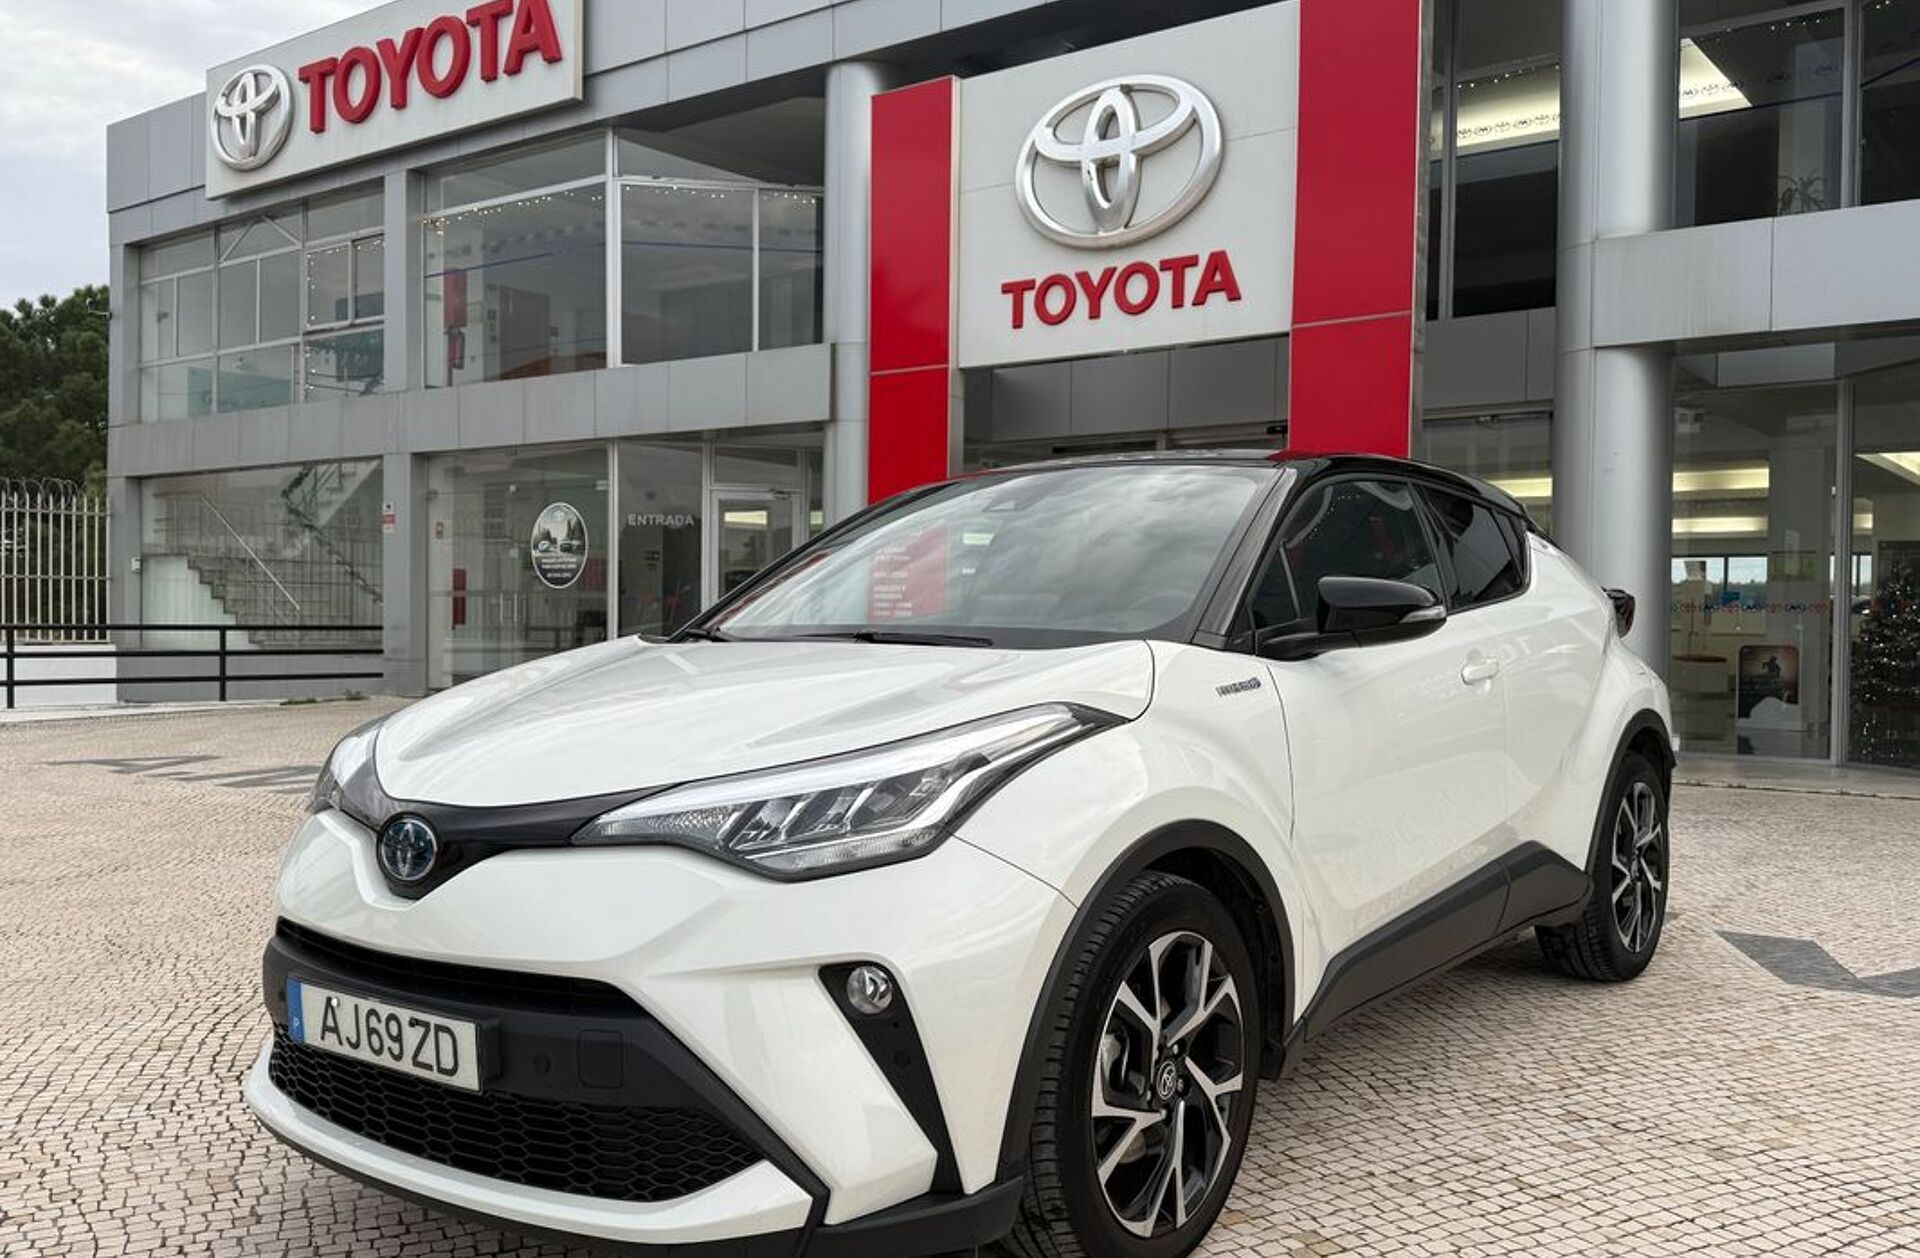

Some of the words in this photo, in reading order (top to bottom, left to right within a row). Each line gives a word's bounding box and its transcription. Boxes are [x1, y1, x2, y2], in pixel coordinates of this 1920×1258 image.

[298, 0, 562, 133] TOYOTA
[1001, 249, 1242, 329] TOYOTA
[627, 514, 695, 527] ENTRADA
